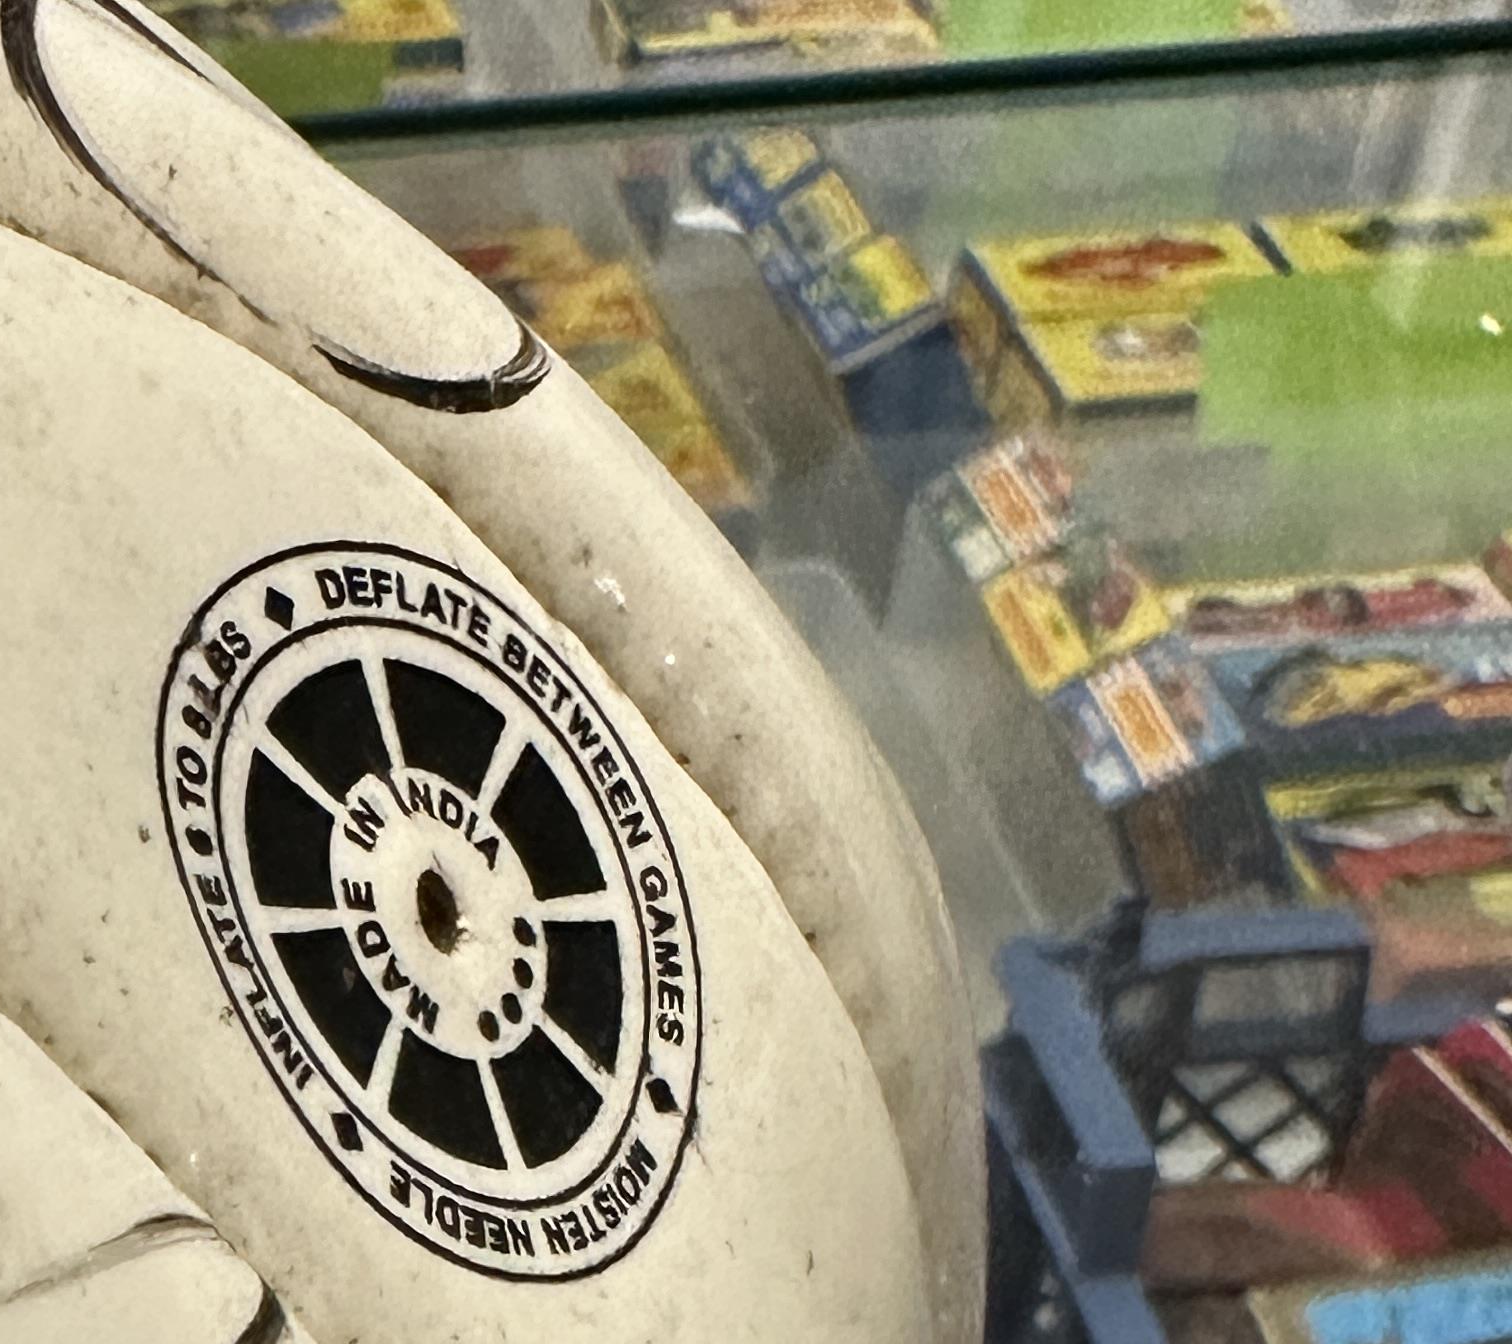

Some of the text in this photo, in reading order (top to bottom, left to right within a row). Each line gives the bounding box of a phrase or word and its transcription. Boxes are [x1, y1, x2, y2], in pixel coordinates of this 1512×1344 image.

[176, 745, 208, 812] TO
[314, 565, 685, 1047] DEFLATE BETWEEN GAMES
[195, 874, 315, 1091] INFLATE
[341, 772, 500, 1035] MADE IN INDIA
[390, 1138, 658, 1257] MOISTEN NEEDLE
